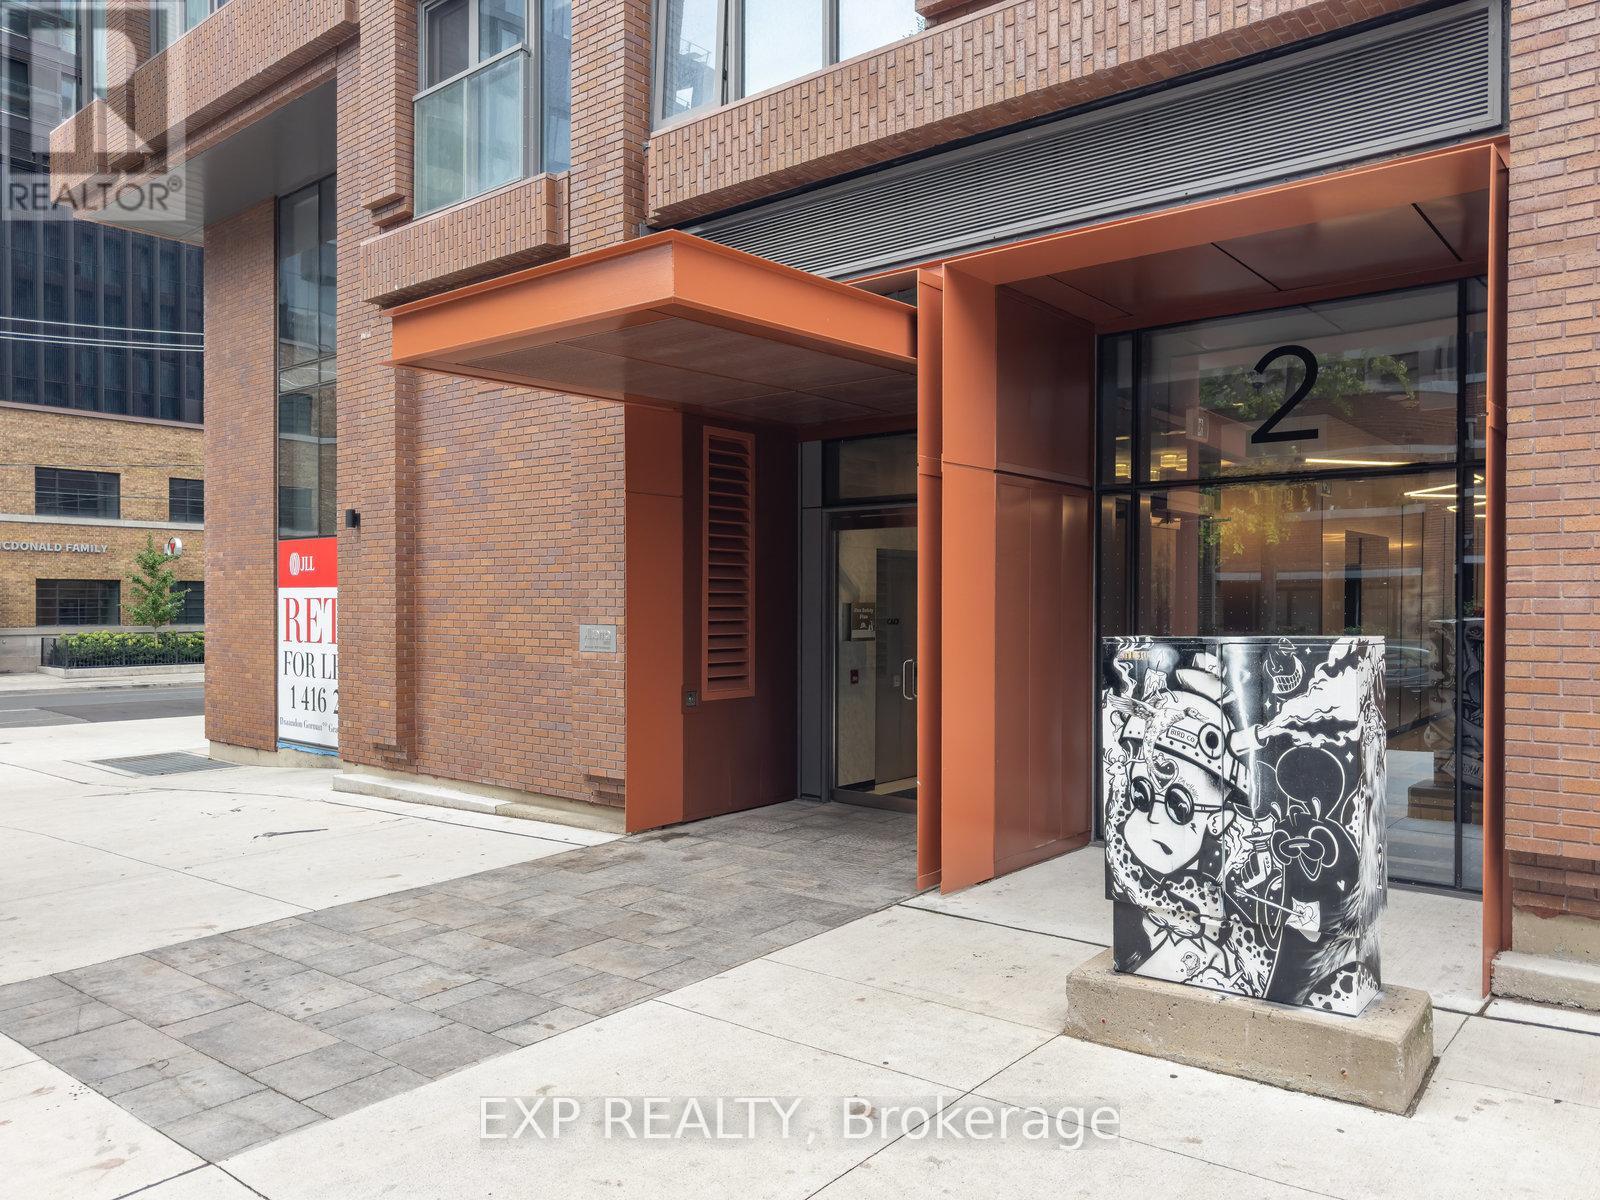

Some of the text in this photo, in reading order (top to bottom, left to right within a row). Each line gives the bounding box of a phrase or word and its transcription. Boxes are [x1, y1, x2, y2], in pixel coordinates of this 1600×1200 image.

[1251, 345, 1318, 444] 2
[0, 541, 108, 553] CDONALD FAMILY
[300, 555, 315, 571] JLL
[284, 651, 316, 679] FOR
[291, 685, 296, 709] 1
[301, 686, 327, 713] 416
